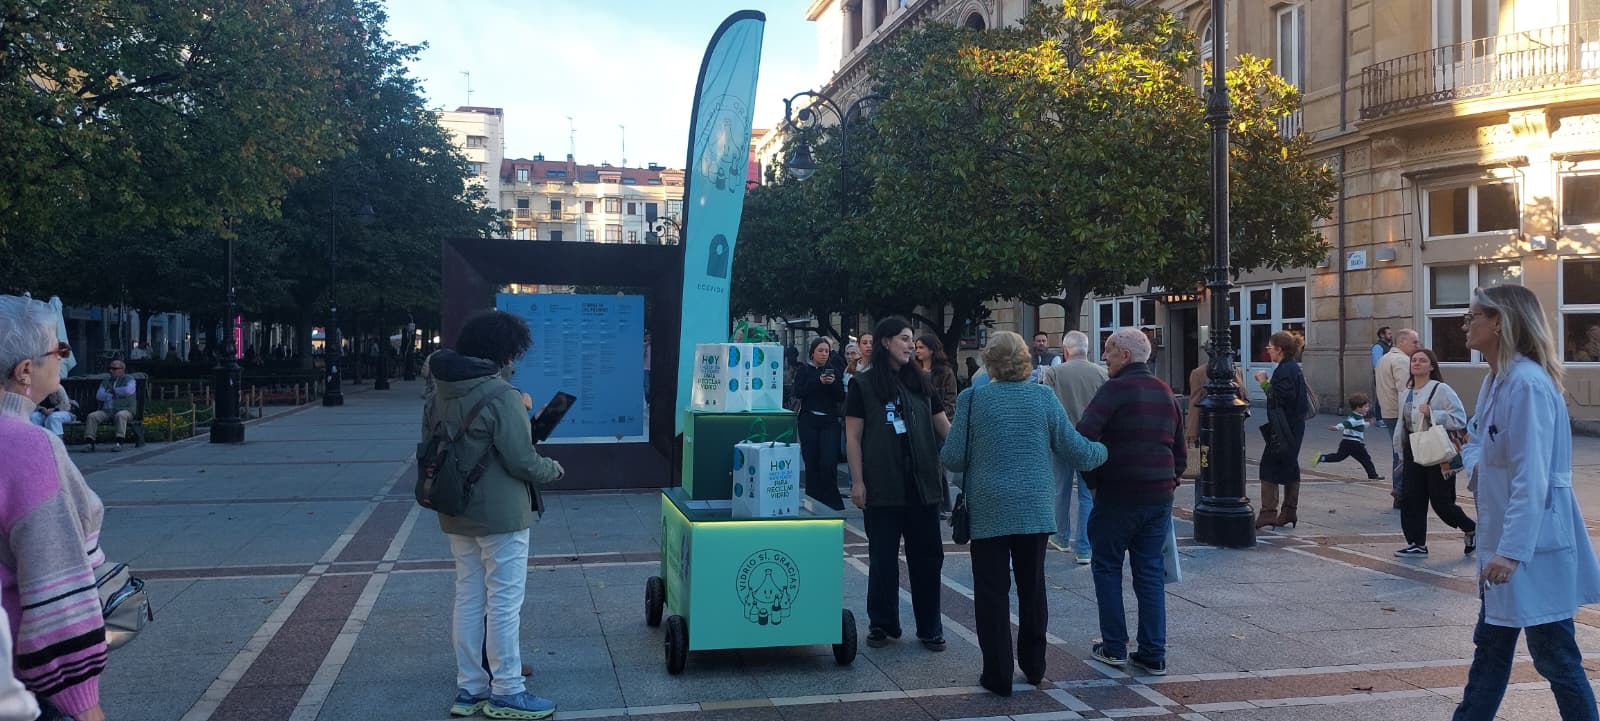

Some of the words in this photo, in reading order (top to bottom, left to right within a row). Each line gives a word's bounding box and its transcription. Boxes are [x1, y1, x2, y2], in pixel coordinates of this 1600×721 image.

[702, 354, 720, 365] HOY
[770, 459, 792, 471] HOY
[740, 559, 757, 591] VIDRIO
[774, 554, 797, 590] GRACIAS
